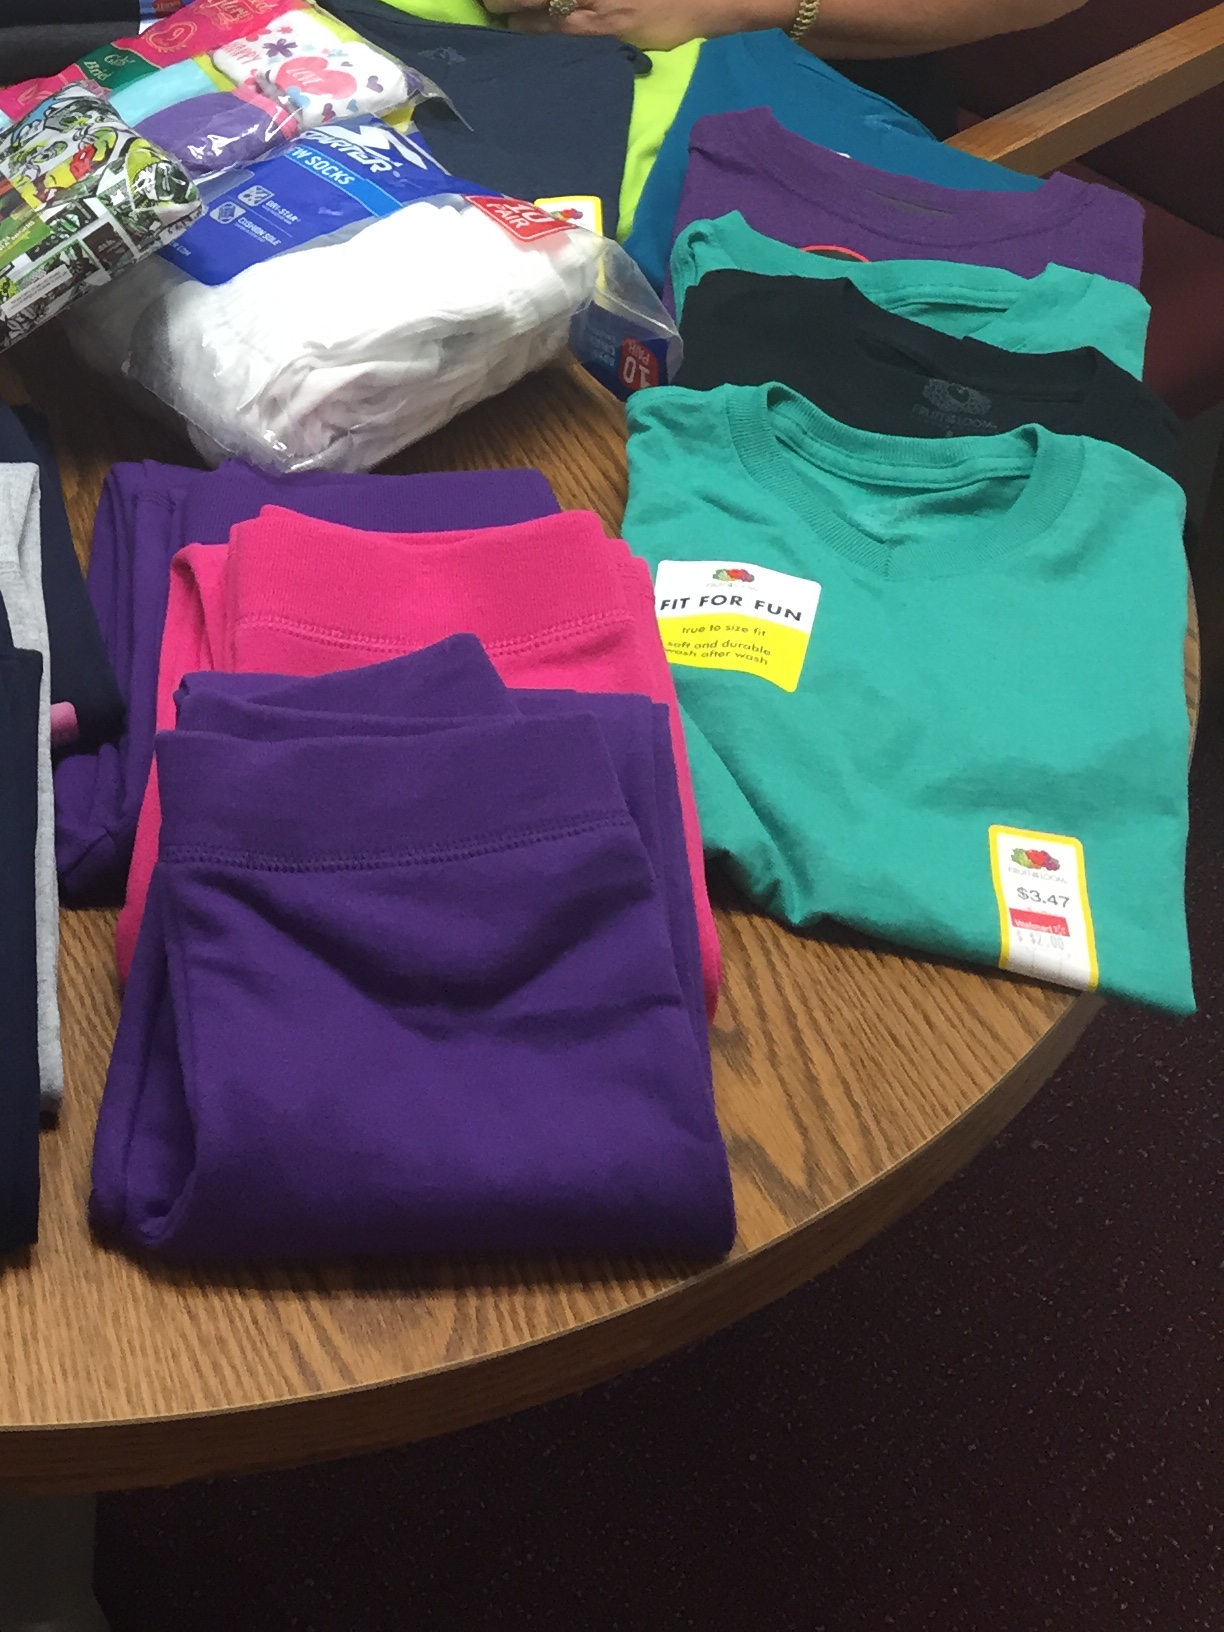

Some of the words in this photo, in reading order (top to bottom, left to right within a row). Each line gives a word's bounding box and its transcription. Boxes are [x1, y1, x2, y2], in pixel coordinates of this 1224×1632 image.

[304, 155, 355, 185] SOCKS
[660, 597, 690, 611] FIT
[698, 594, 743, 607] FOR
[754, 599, 802, 622] FUN
[682, 626, 706, 634] true
[709, 624, 721, 632] to
[725, 624, 749, 633] size
[753, 627, 766, 637] fit
[665, 648, 697, 658] wash
[700, 649, 731, 658] after
[735, 652, 768, 666] wash
[667, 641, 691, 649] soft
[694, 639, 719, 649] and
[722, 639, 771, 656] durable
[1016, 886, 1070, 909] $3.47
